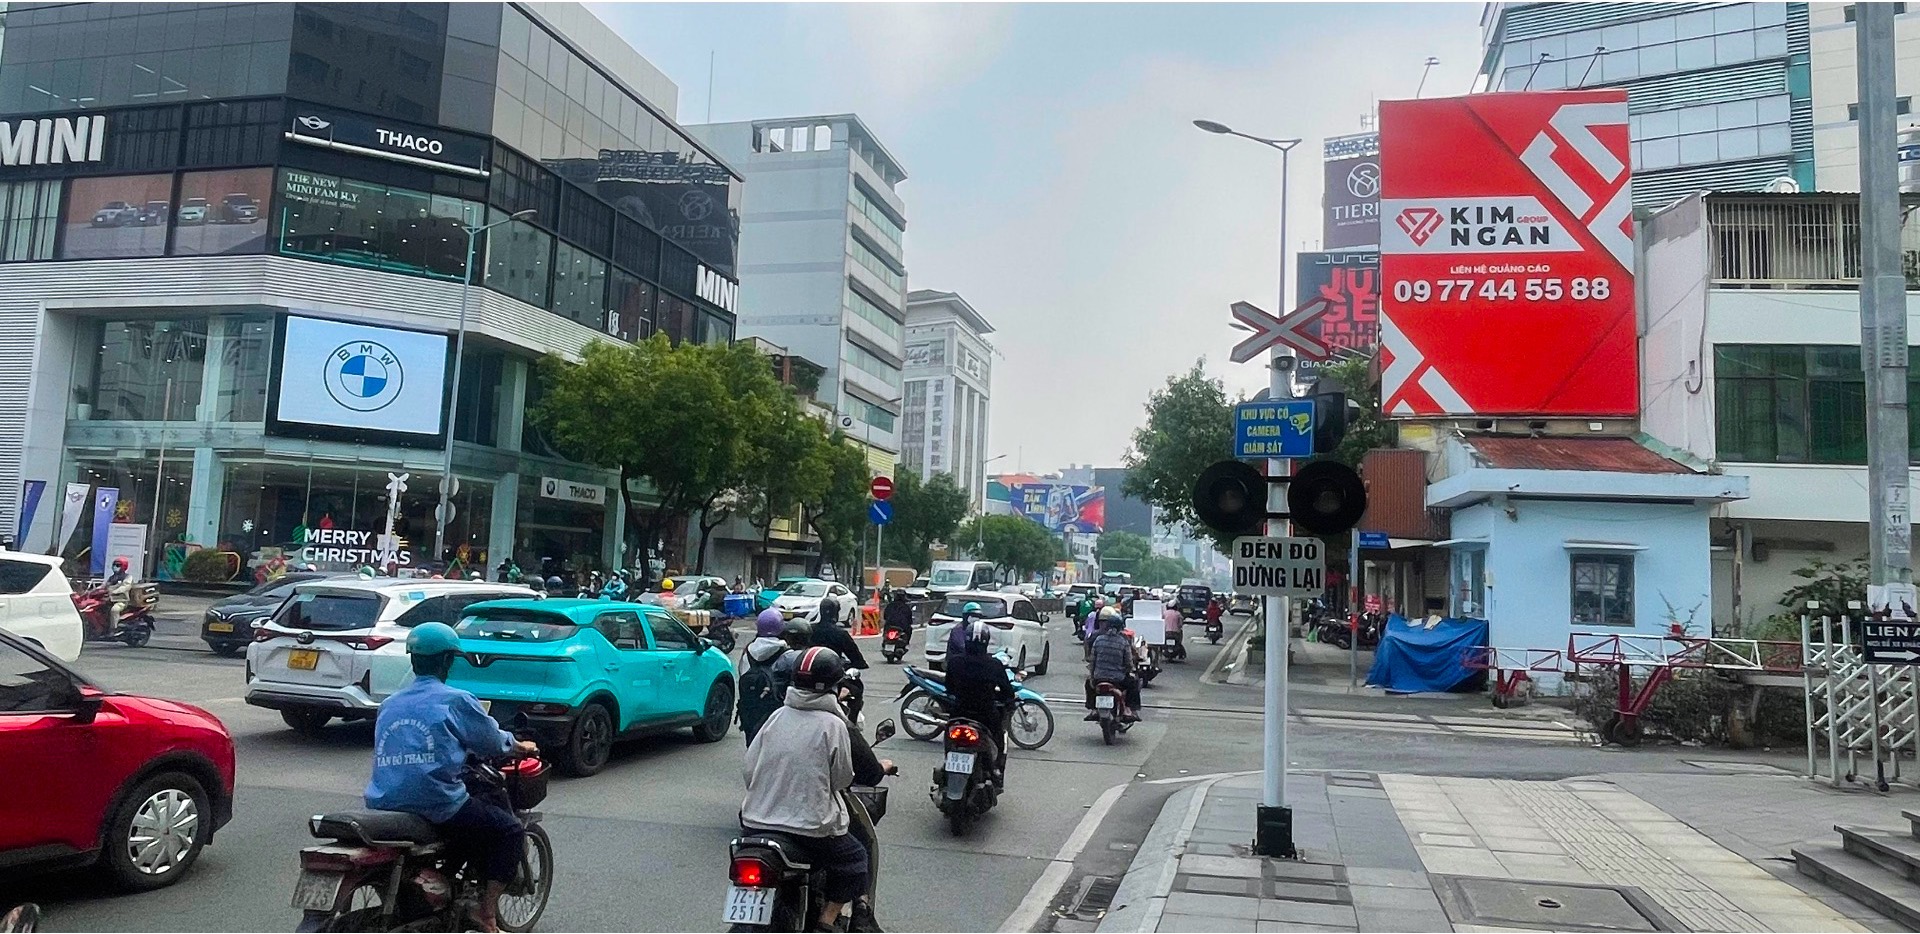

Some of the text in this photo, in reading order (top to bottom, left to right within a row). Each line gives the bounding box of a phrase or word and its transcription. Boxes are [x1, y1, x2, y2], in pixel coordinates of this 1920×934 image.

[0, 115, 105, 166] MINI
[376, 128, 443, 154] THACO
[286, 182, 313, 195] MINI
[287, 172, 338, 188] THE NEW
[1450, 206, 1549, 226] KIM GROUP
[696, 264, 739, 315] MINI
[1394, 277, 1610, 302] 09 77 44 55 88
[337, 344, 394, 366] BMW
[1241, 408, 1258, 420] KHU
[1246, 424, 1281, 437] CAMERA
[569, 485, 596, 499] THACO
[1891, 514, 1902, 524] 11
[303, 528, 372, 546] MERRY
[302, 547, 411, 566] CHRISTMAS
[1241, 538, 1317, 560] ĐÈN ĐỎ
[1236, 562, 1321, 592] DỪNG LẠI
[1866, 626, 1909, 637] LIEN
[730, 905, 764, 922] 2511
